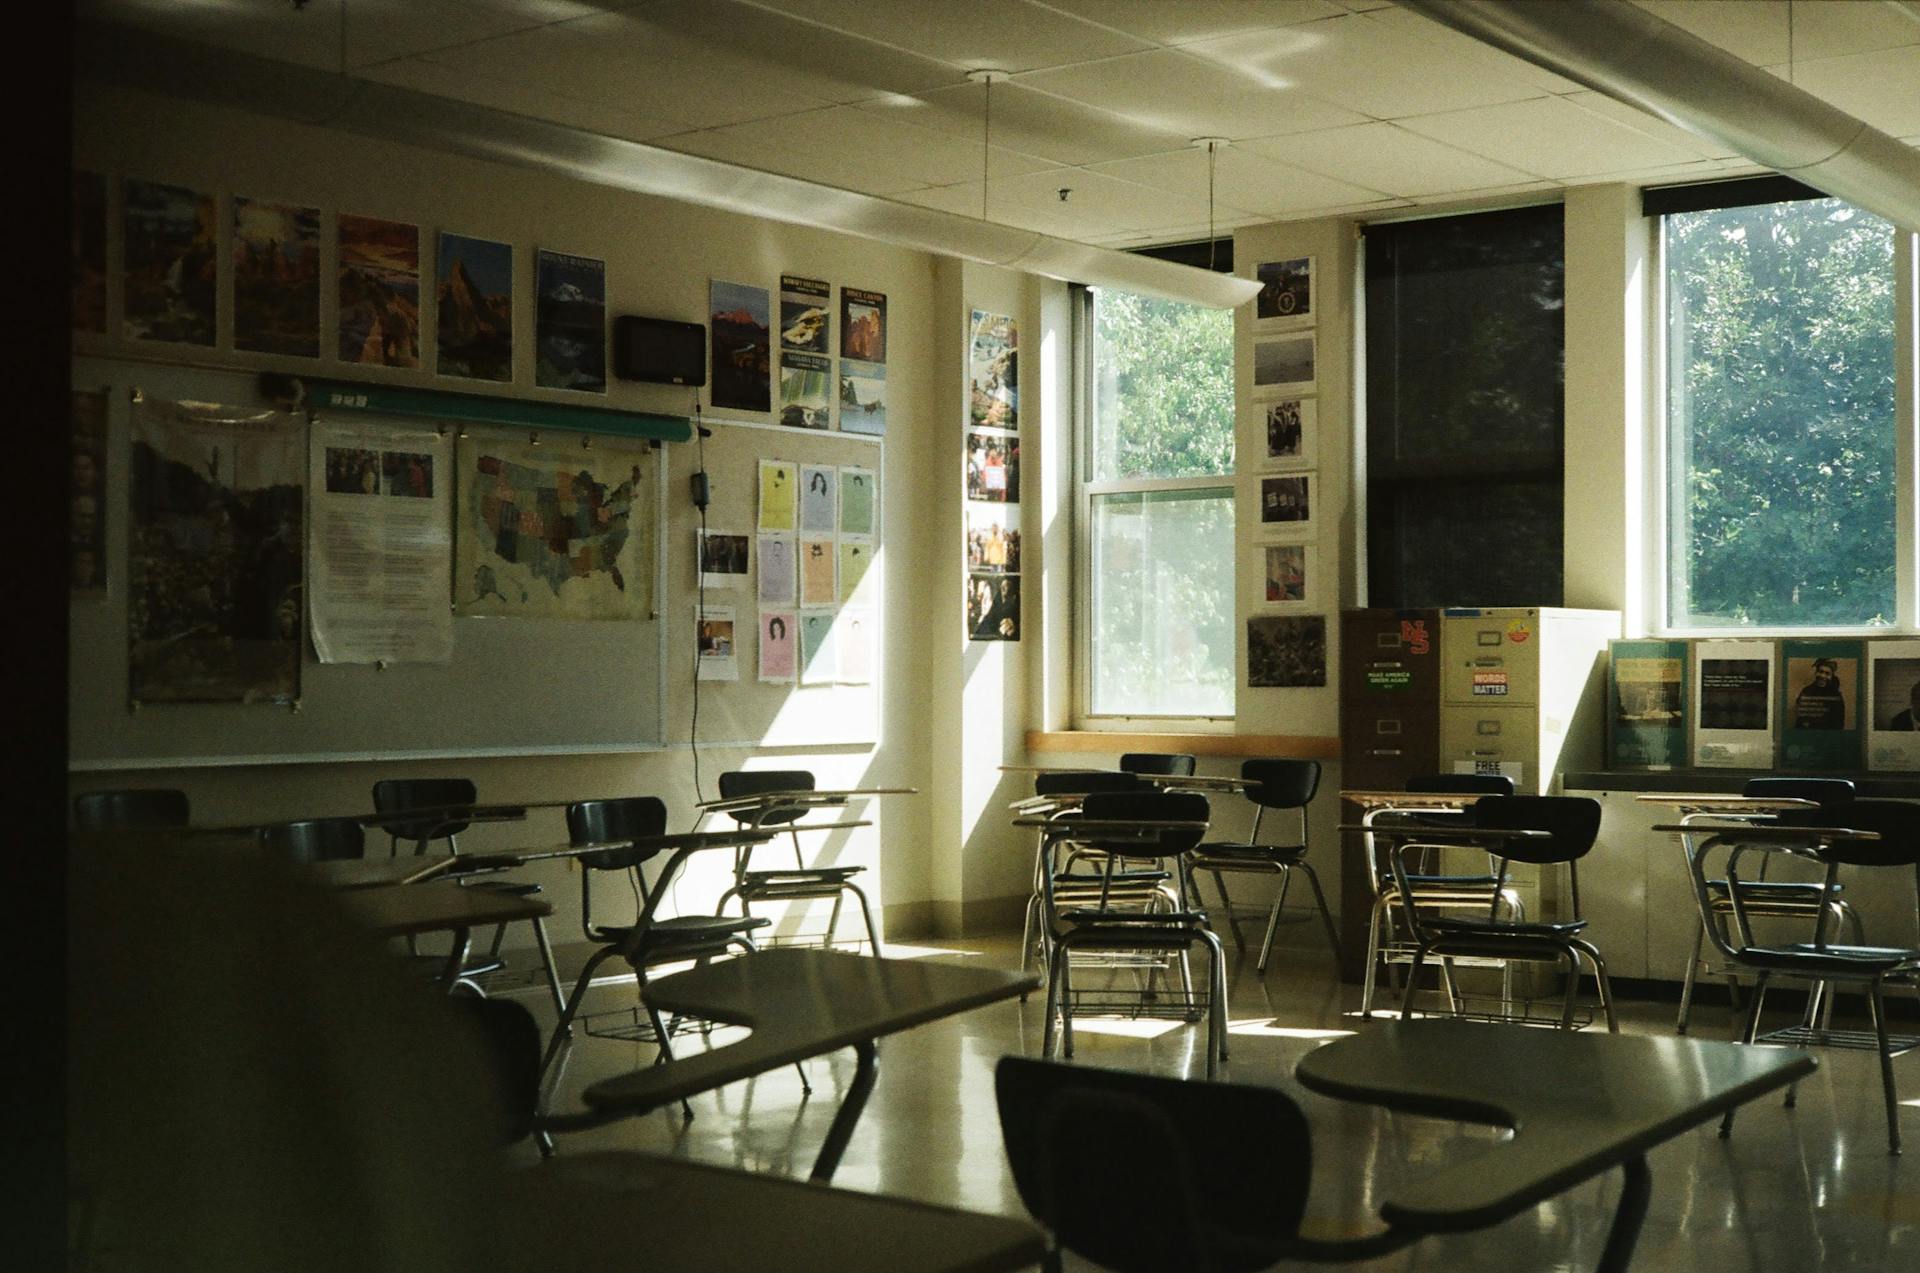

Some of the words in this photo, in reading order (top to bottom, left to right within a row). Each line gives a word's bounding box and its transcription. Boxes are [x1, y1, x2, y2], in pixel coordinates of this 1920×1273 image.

[1474, 673, 1506, 684] WORDS
[1474, 685, 1506, 694] MATTER
[1475, 760, 1500, 770] FREE
